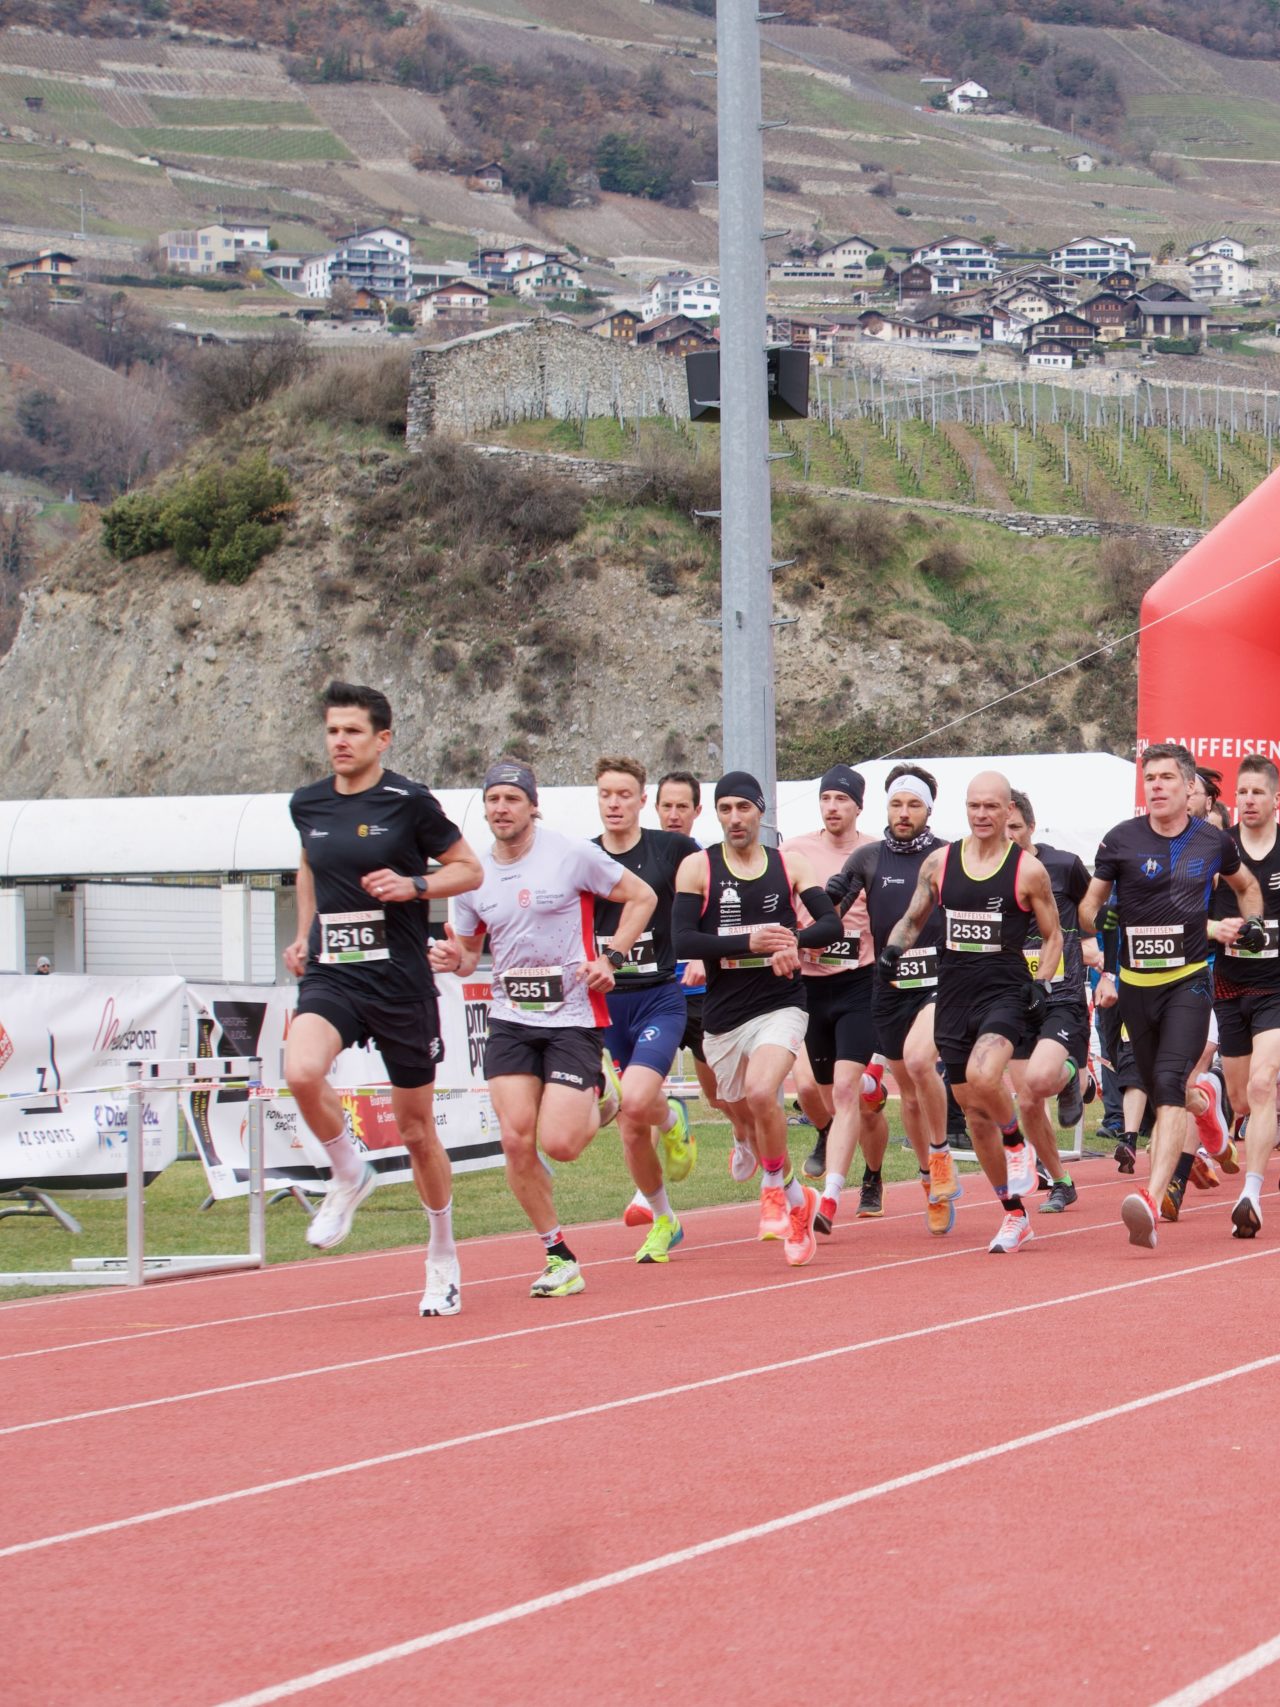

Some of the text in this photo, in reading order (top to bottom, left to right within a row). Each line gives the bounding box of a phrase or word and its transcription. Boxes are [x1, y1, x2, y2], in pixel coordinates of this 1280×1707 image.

[952, 911, 993, 921] RAIFFEISEN
[327, 927, 375, 947] 2516
[952, 923, 992, 940] 2533
[1134, 927, 1174, 935] RAIFFEISEN
[627, 946, 645, 962] 17
[824, 941, 851, 955] 22
[1135, 939, 1175, 955] 2550
[508, 981, 551, 998] 2551
[32, 1128, 75, 1145] SPORTS
